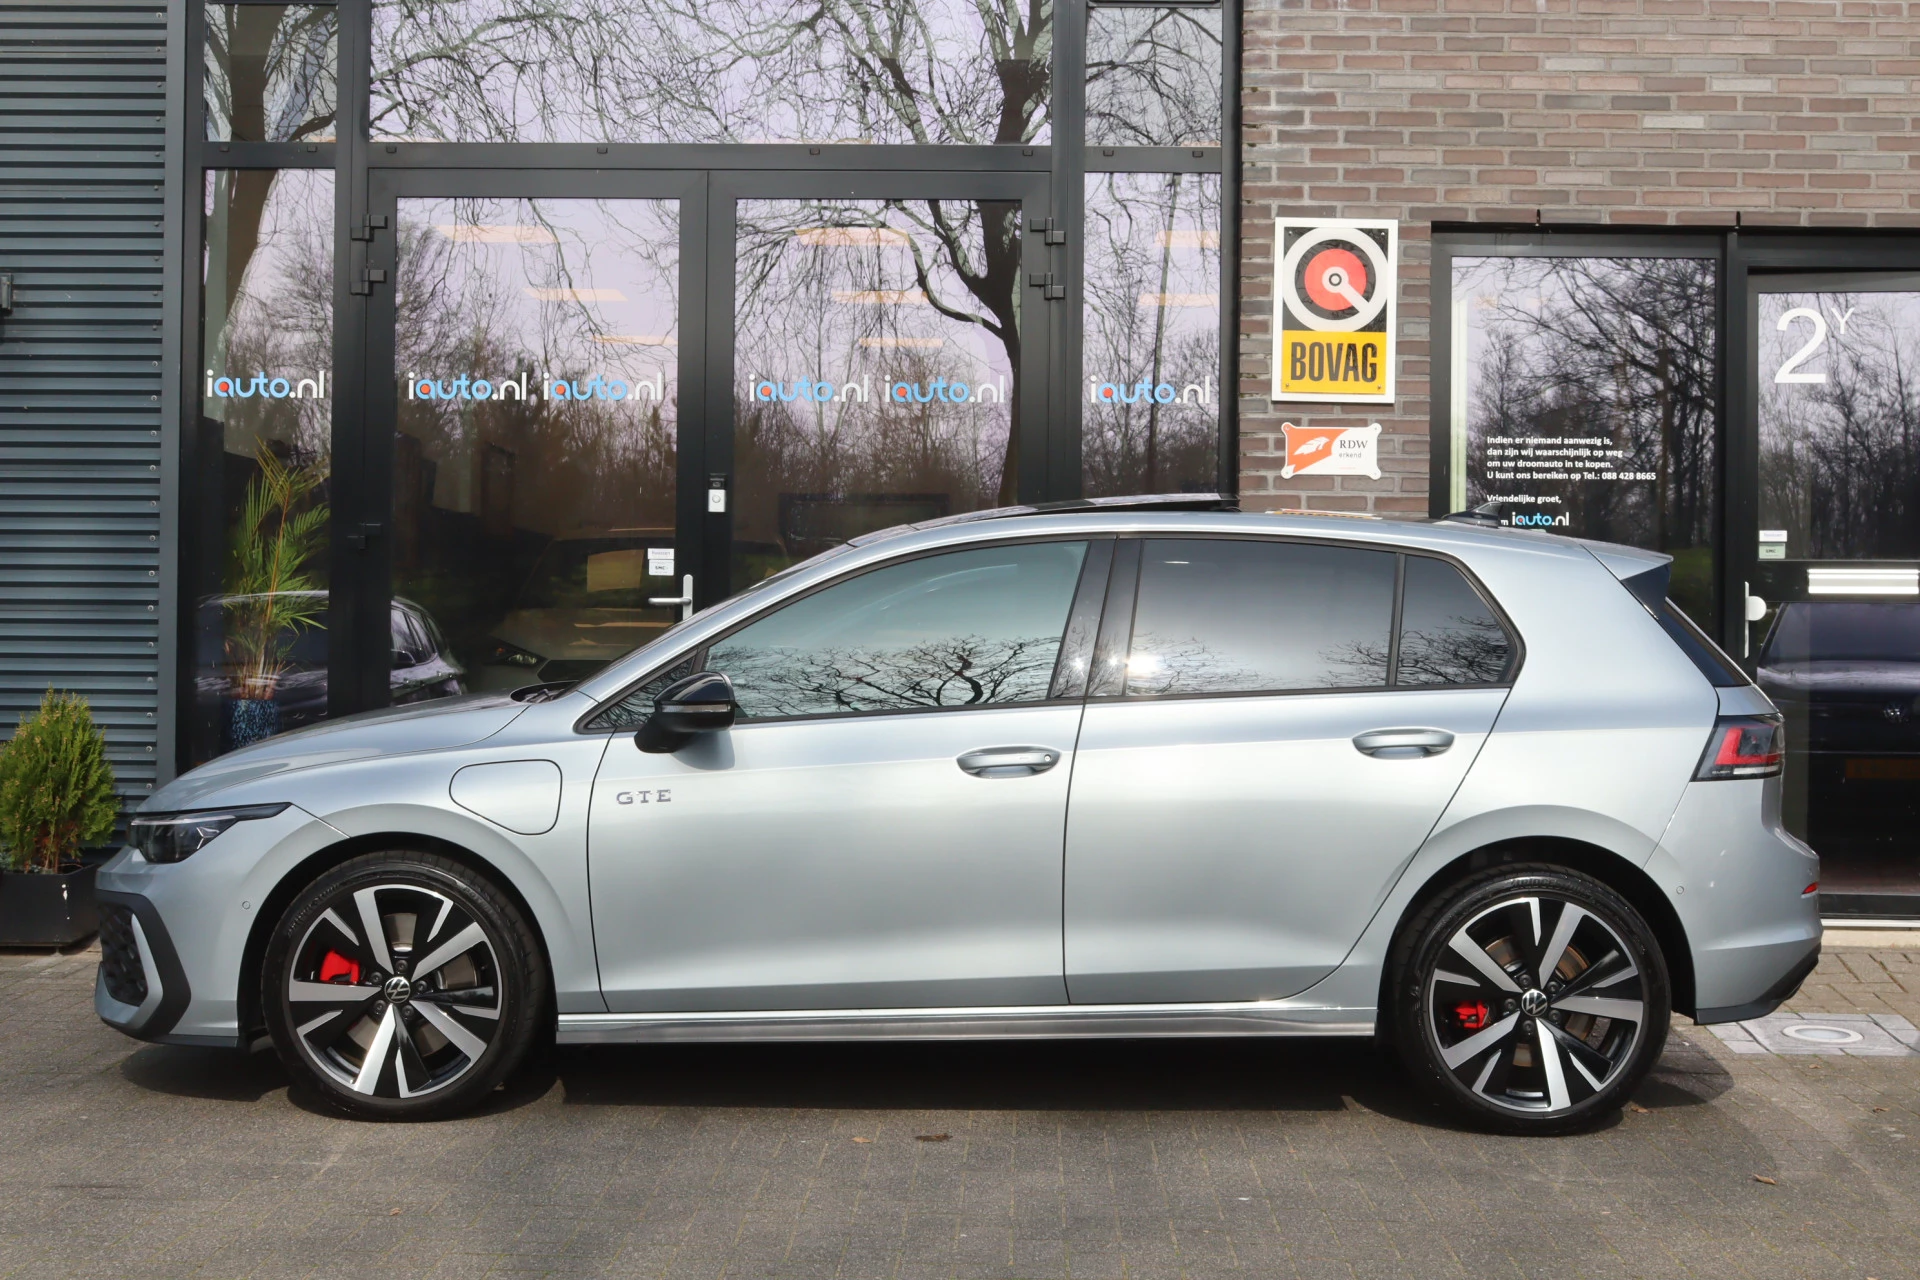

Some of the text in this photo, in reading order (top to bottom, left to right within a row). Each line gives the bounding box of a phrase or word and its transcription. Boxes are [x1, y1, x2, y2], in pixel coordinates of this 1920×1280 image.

[1290, 341, 1378, 383] BOVAG
[207, 369, 325, 399] iauto.nl
[408, 371, 527, 401] iauto.nl
[543, 371, 663, 401] iauto.nl
[749, 373, 869, 403] iauto.nl
[884, 374, 1005, 403] iauto.nl
[1090, 375, 1211, 404] iauto.nl
[1339, 439, 1369, 449] RDW
[1487, 436, 1613, 446] Indien er niemand aanwezig is,
[1487, 448, 1623, 458] dan zijn wij waarschijnlijk op weg
[1517, 459, 1563, 468] droomauto
[1564, 460, 1574, 468] in
[1585, 460, 1614, 469] kopen.
[1487, 471, 1494, 479] U
[1495, 471, 1514, 479] kunt
[1532, 471, 1569, 480] bereiken
[1570, 473, 1582, 481] op
[1583, 471, 1600, 480] Tel.:
[1601, 472, 1618, 480] 088
[1618, 472, 1635, 480] 428
[1635, 472, 1657, 480] 8665
[1486, 494, 1562, 504] Vriendelijke groet,
[1512, 511, 1570, 526] iauto.nl
[616, 789, 672, 805] GTE
